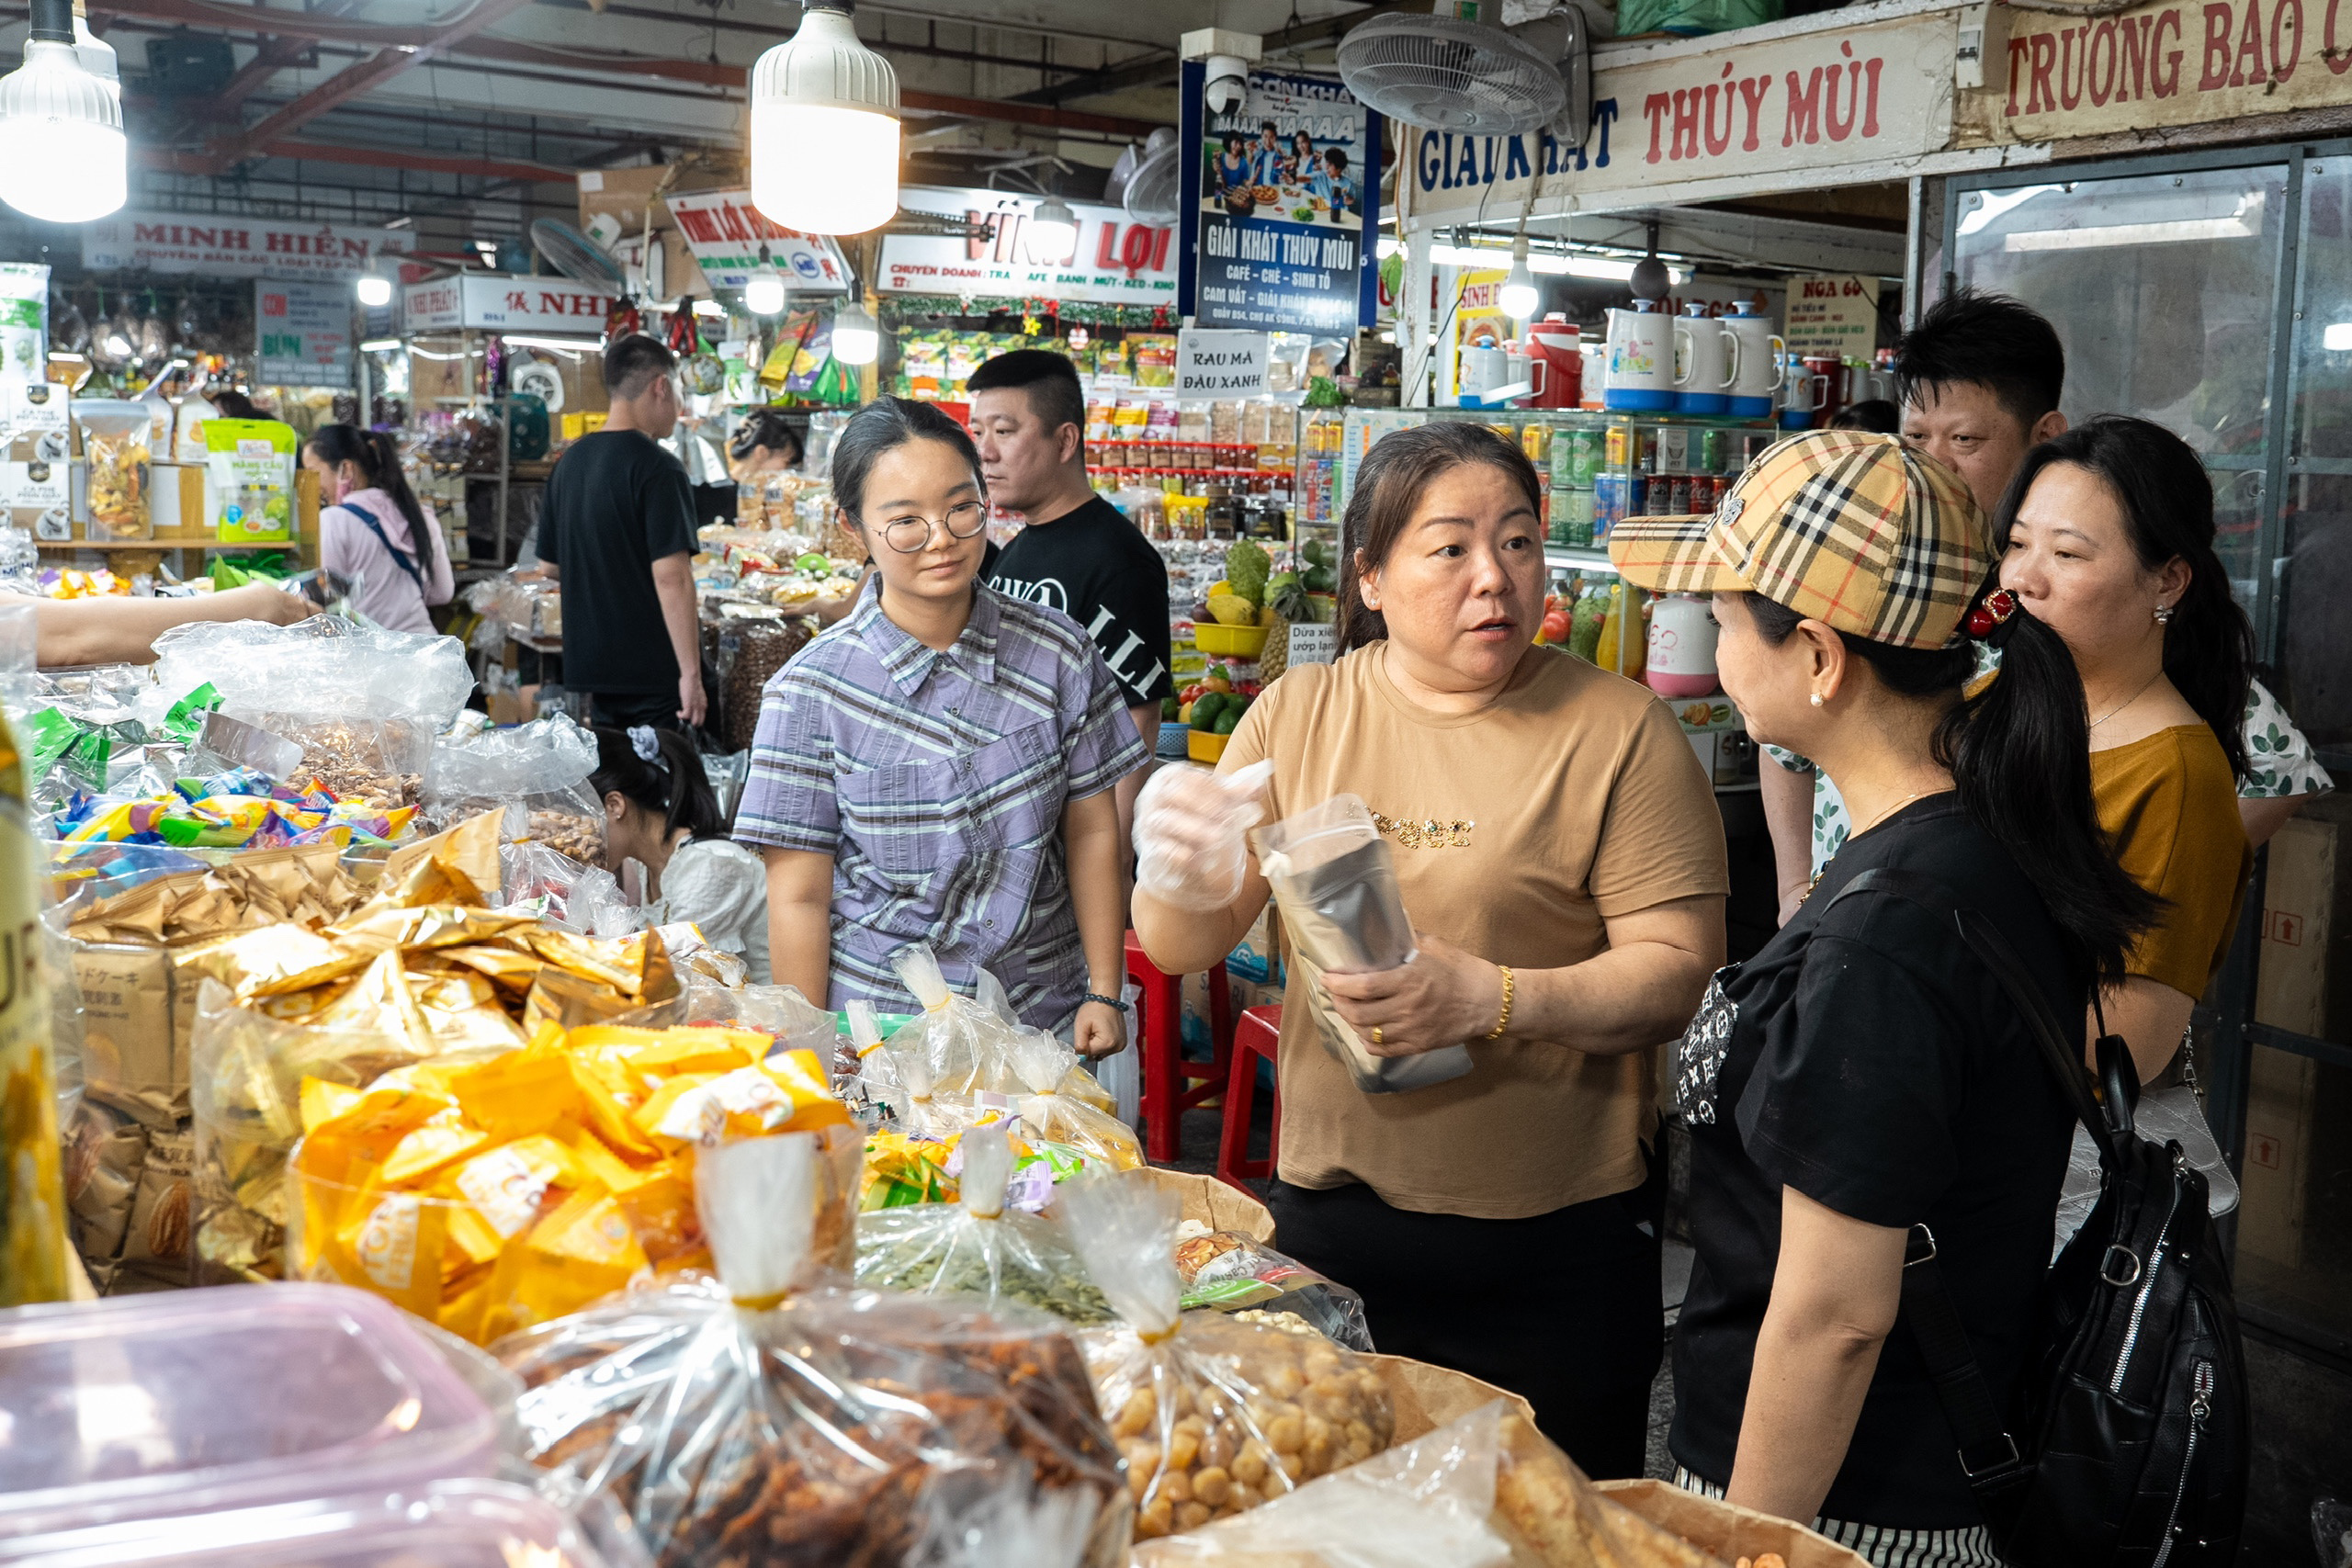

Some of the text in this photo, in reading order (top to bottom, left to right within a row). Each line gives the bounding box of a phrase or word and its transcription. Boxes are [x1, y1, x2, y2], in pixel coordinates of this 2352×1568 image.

[1643, 61, 1772, 164] THÚY
[1781, 39, 1884, 148] MÙI
[134, 223, 250, 251] MINH
[1207, 218, 1354, 271] GIẢI KHÁT THÚY MÙI
[1226, 264, 1250, 281] CAFÉ
[1261, 267, 1281, 284] CHÈ
[1292, 272, 1315, 288] SINH
[1204, 286, 1226, 302] CAM
[1257, 289, 1279, 307] GIẢI
[1461, 284, 1490, 309] SINH
[1193, 353, 1227, 366] RAU
[1220, 374, 1261, 389] XANH
[1293, 626, 1338, 637] Dừa xiê
[1293, 641, 1317, 652] ướp
